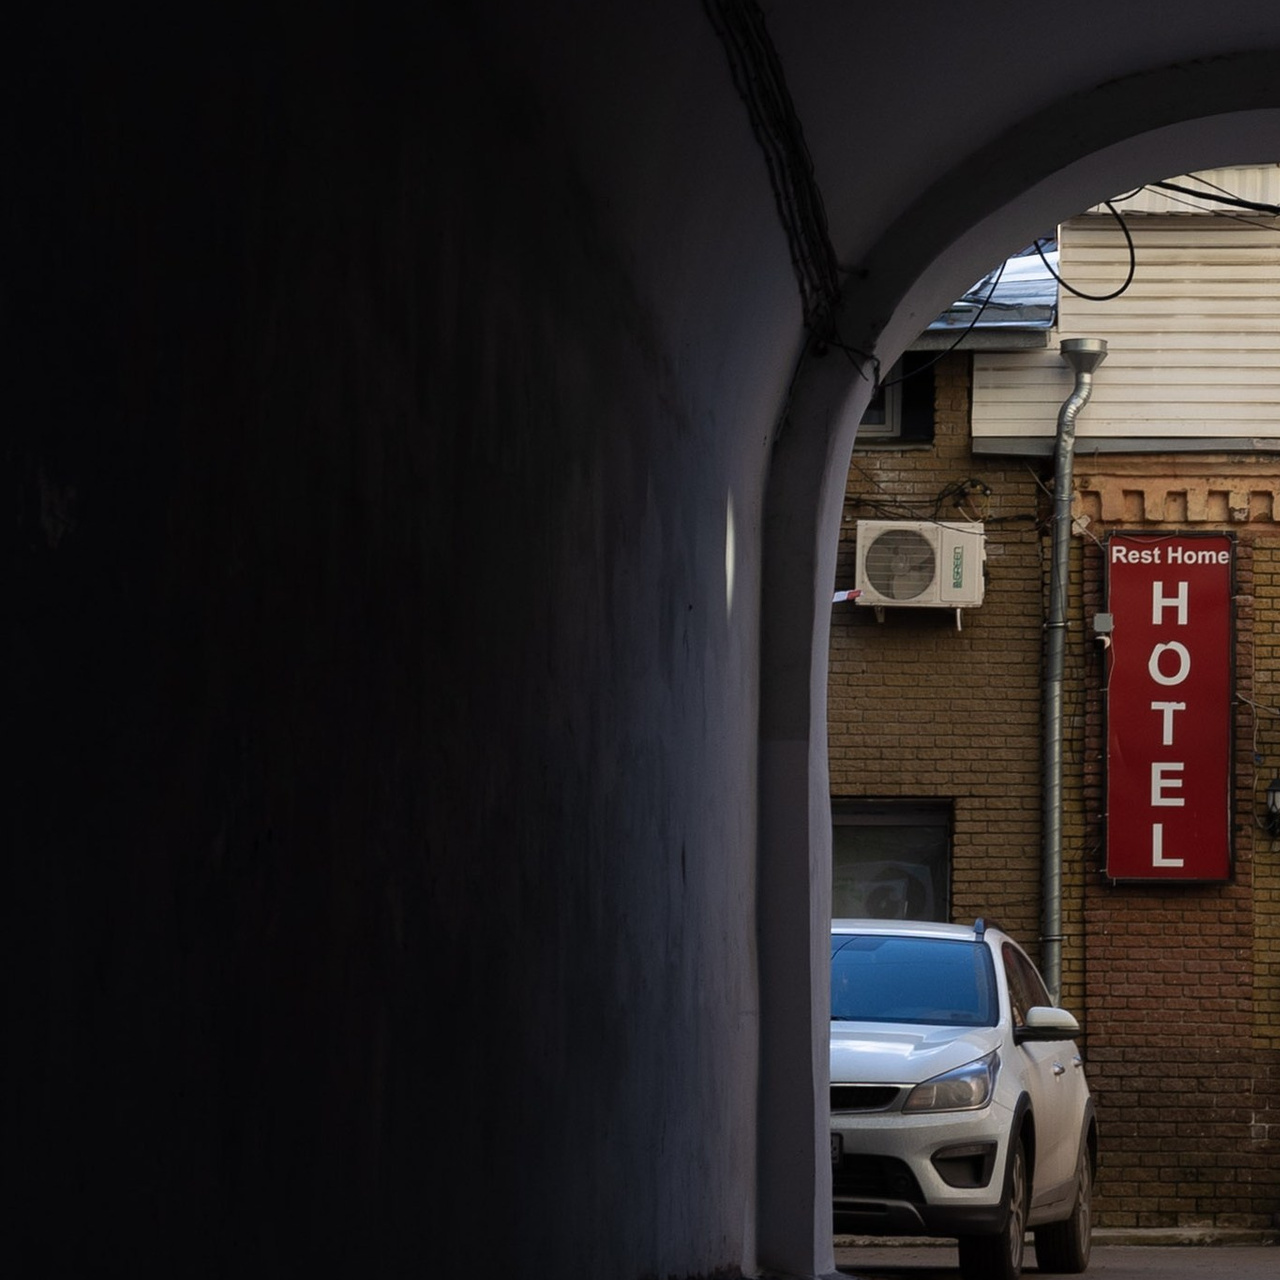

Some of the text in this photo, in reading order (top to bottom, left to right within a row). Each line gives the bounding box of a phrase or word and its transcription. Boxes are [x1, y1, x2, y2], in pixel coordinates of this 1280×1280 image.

[1111, 546, 1230, 565] Rest Home
[1149, 581, 1191, 867] HOTEL
